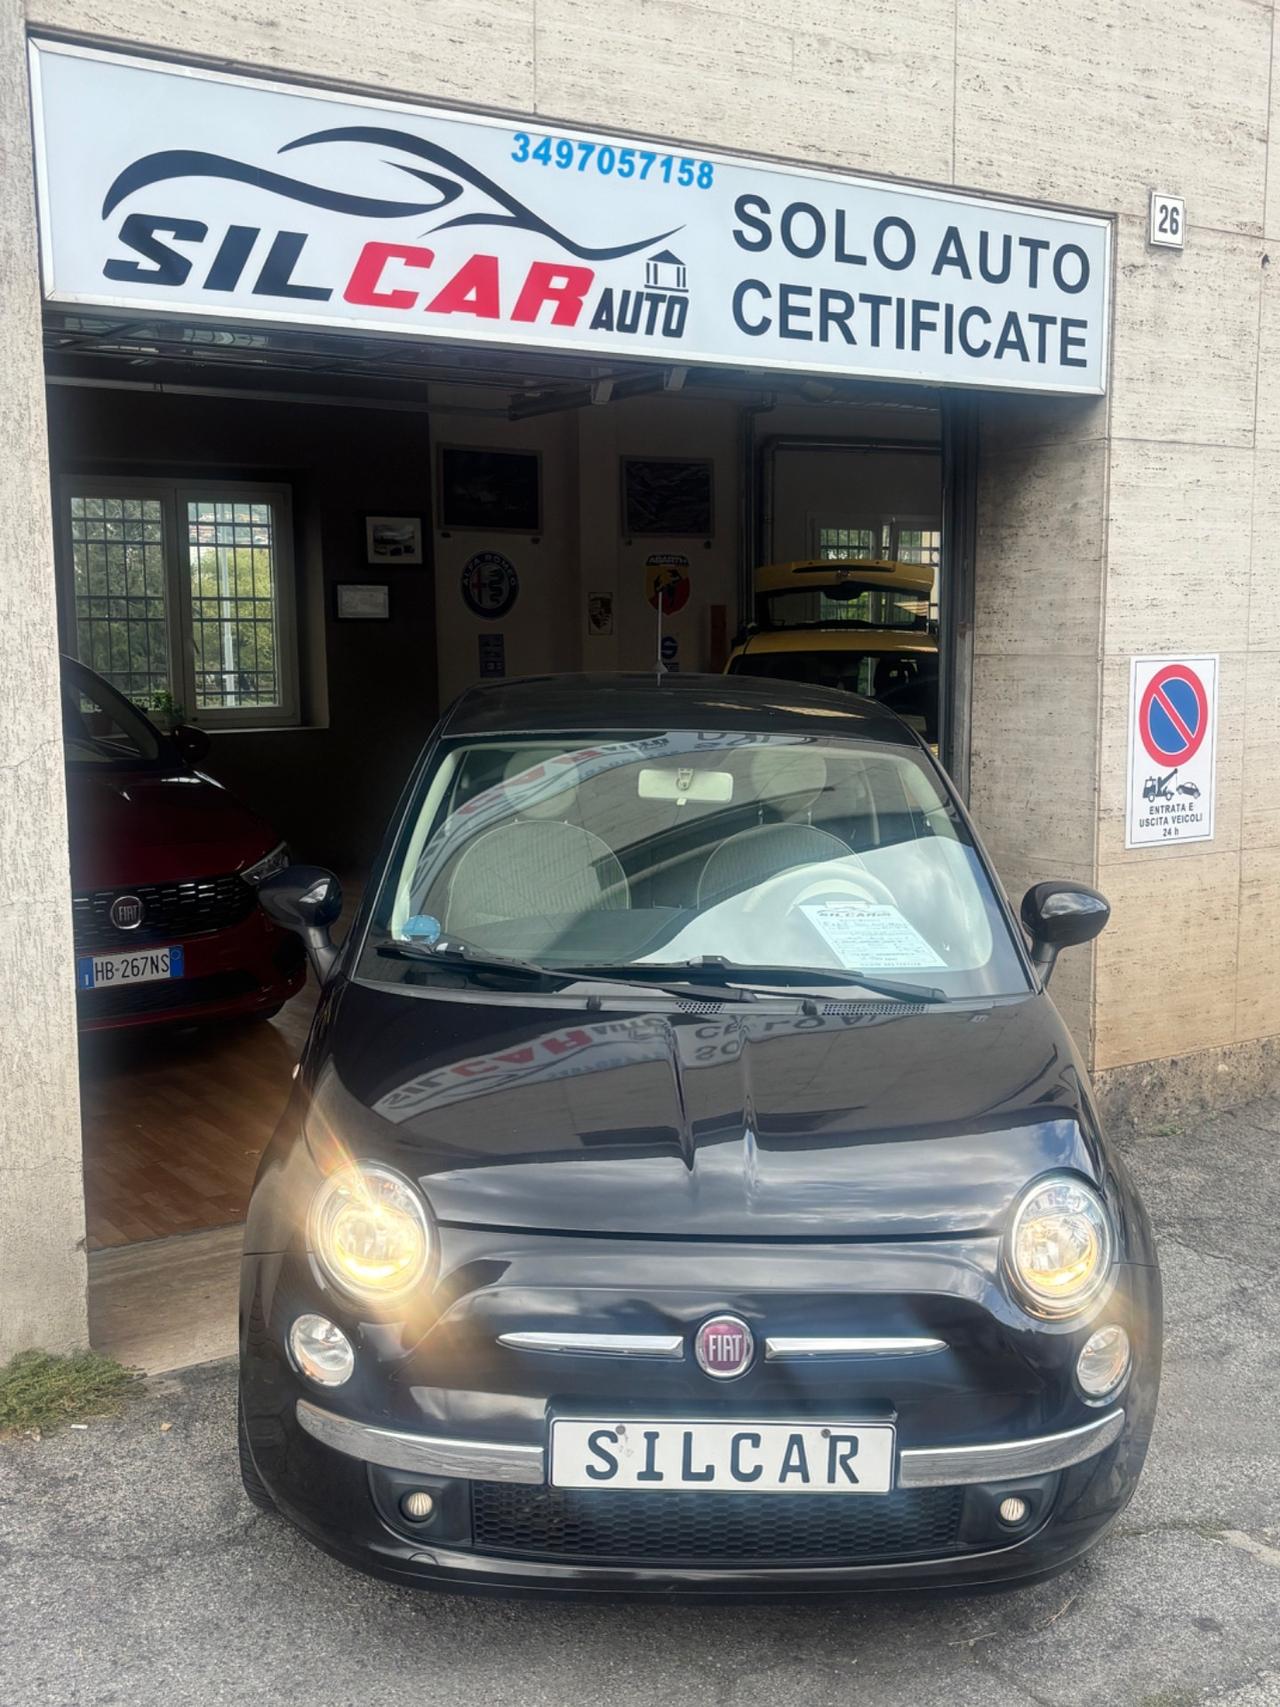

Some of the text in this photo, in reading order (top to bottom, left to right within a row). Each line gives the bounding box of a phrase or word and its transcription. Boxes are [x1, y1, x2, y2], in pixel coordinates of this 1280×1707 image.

[511, 133, 714, 190] 3497057158
[1158, 204, 1180, 235] 26
[732, 194, 1090, 295] SOLO AUTO
[102, 213, 595, 328] SILCAR
[589, 287, 690, 340] AUTO
[732, 278, 1089, 369] CERTIFICATE
[1139, 813, 1203, 827] USCITA VEICOLI
[1149, 802, 1194, 815] ENTRATA E
[1163, 828, 1172, 837] 24
[118, 905, 138, 921] FIAT
[708, 1334, 742, 1362] FIAT
[585, 1430, 860, 1485] SILCAR
